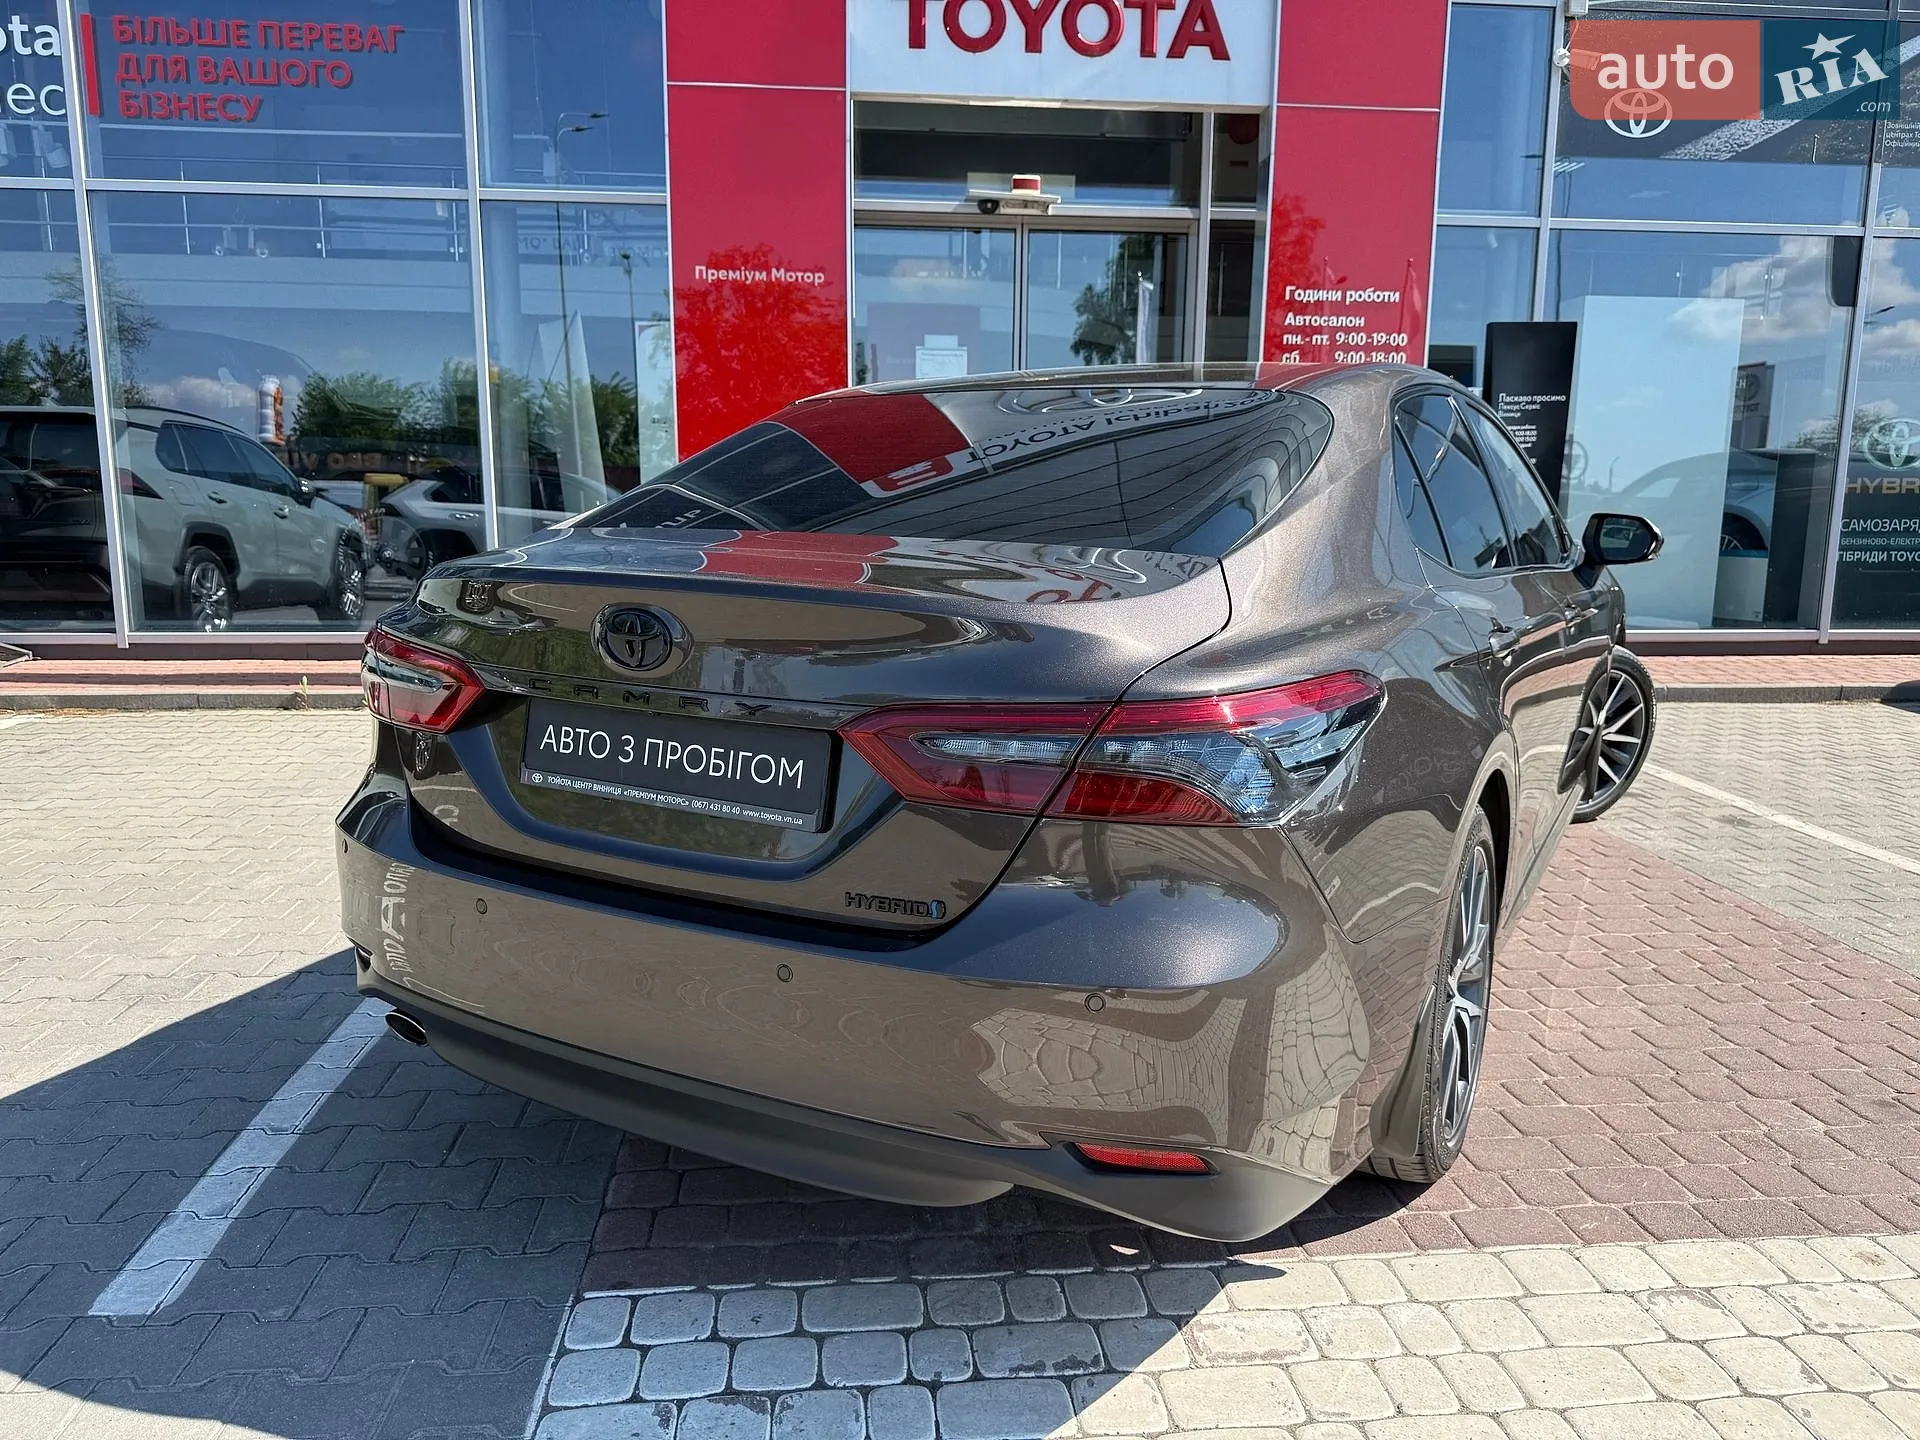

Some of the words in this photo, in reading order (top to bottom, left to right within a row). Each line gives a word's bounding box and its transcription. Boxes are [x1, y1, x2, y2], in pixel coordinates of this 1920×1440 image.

[112, 15, 249, 47] БІЛЬШЕ
[257, 20, 404, 53] ПЕРЕВАГ
[892, 0, 1231, 61] TOYOTA
[115, 53, 188, 85] ДЛЯ
[197, 56, 352, 88] ВАШОГО
[118, 89, 261, 122] БІЗНЕСУ
[694, 264, 767, 285] Преміум
[771, 267, 825, 287] Мотор
[1284, 285, 1342, 304] Години
[1345, 287, 1400, 305] роботи
[1284, 312, 1366, 328] Автосалон
[1335, 332, 1408, 347] 9:00-19:00
[1840, 518, 1920, 533] САМОЗАРЯ
[528, 678, 773, 717] CAMRY
[539, 724, 611, 760] АВТО
[618, 734, 635, 764] З
[643, 738, 805, 790] ПРОБІГОМ
[547, 775, 572, 787] ТОЙОТА
[572, 780, 593, 791] ЦЕНТР
[592, 783, 622, 796] ВІННИЦЯ
[691, 799, 709, 811] (067)
[709, 802, 721, 812] 431
[722, 803, 731, 814] 80
[731, 806, 741, 815] 40
[742, 808, 804, 825] www.toyota.vn.ua
[844, 891, 930, 918] HYBRID
